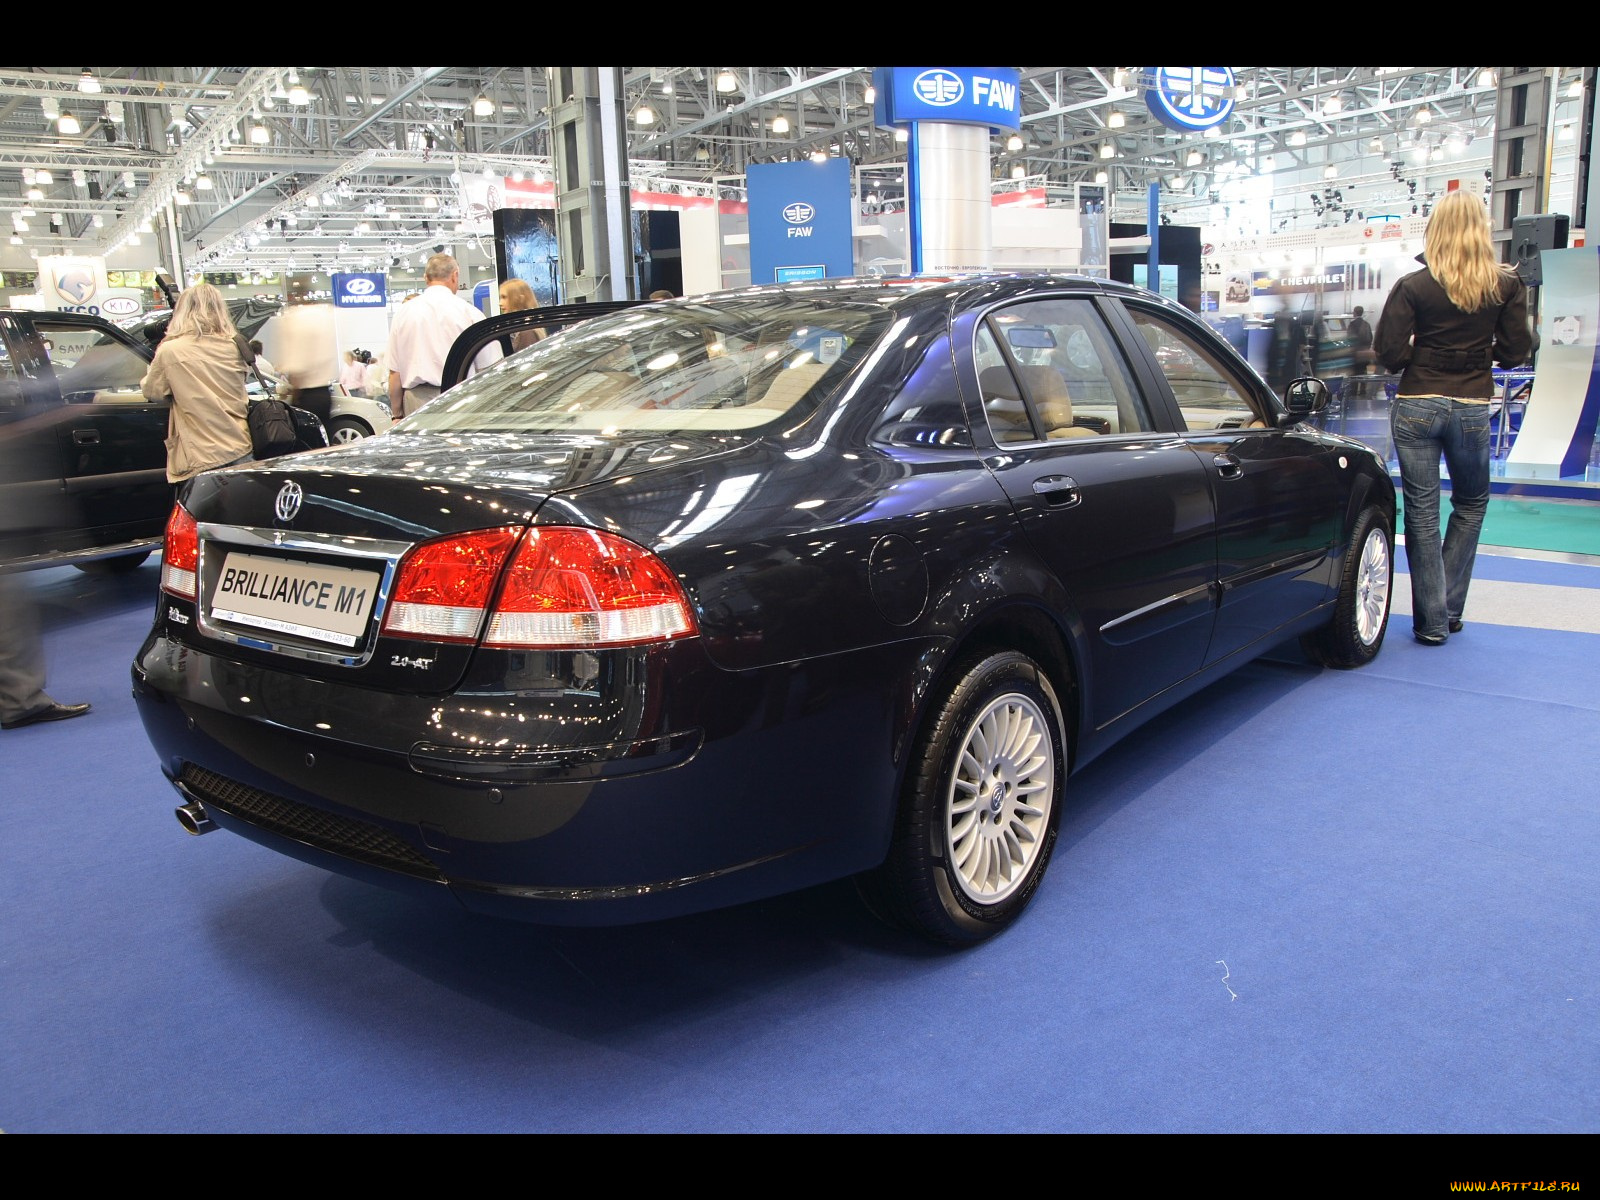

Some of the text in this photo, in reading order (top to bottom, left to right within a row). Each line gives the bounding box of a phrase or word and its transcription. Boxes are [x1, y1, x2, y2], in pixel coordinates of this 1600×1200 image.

[972, 76, 1016, 112] FAW
[787, 226, 813, 238] FAW
[341, 295, 382, 304] HYUNDAI
[109, 301, 134, 311] KIA
[221, 567, 367, 616] BRILLIANCE M1
